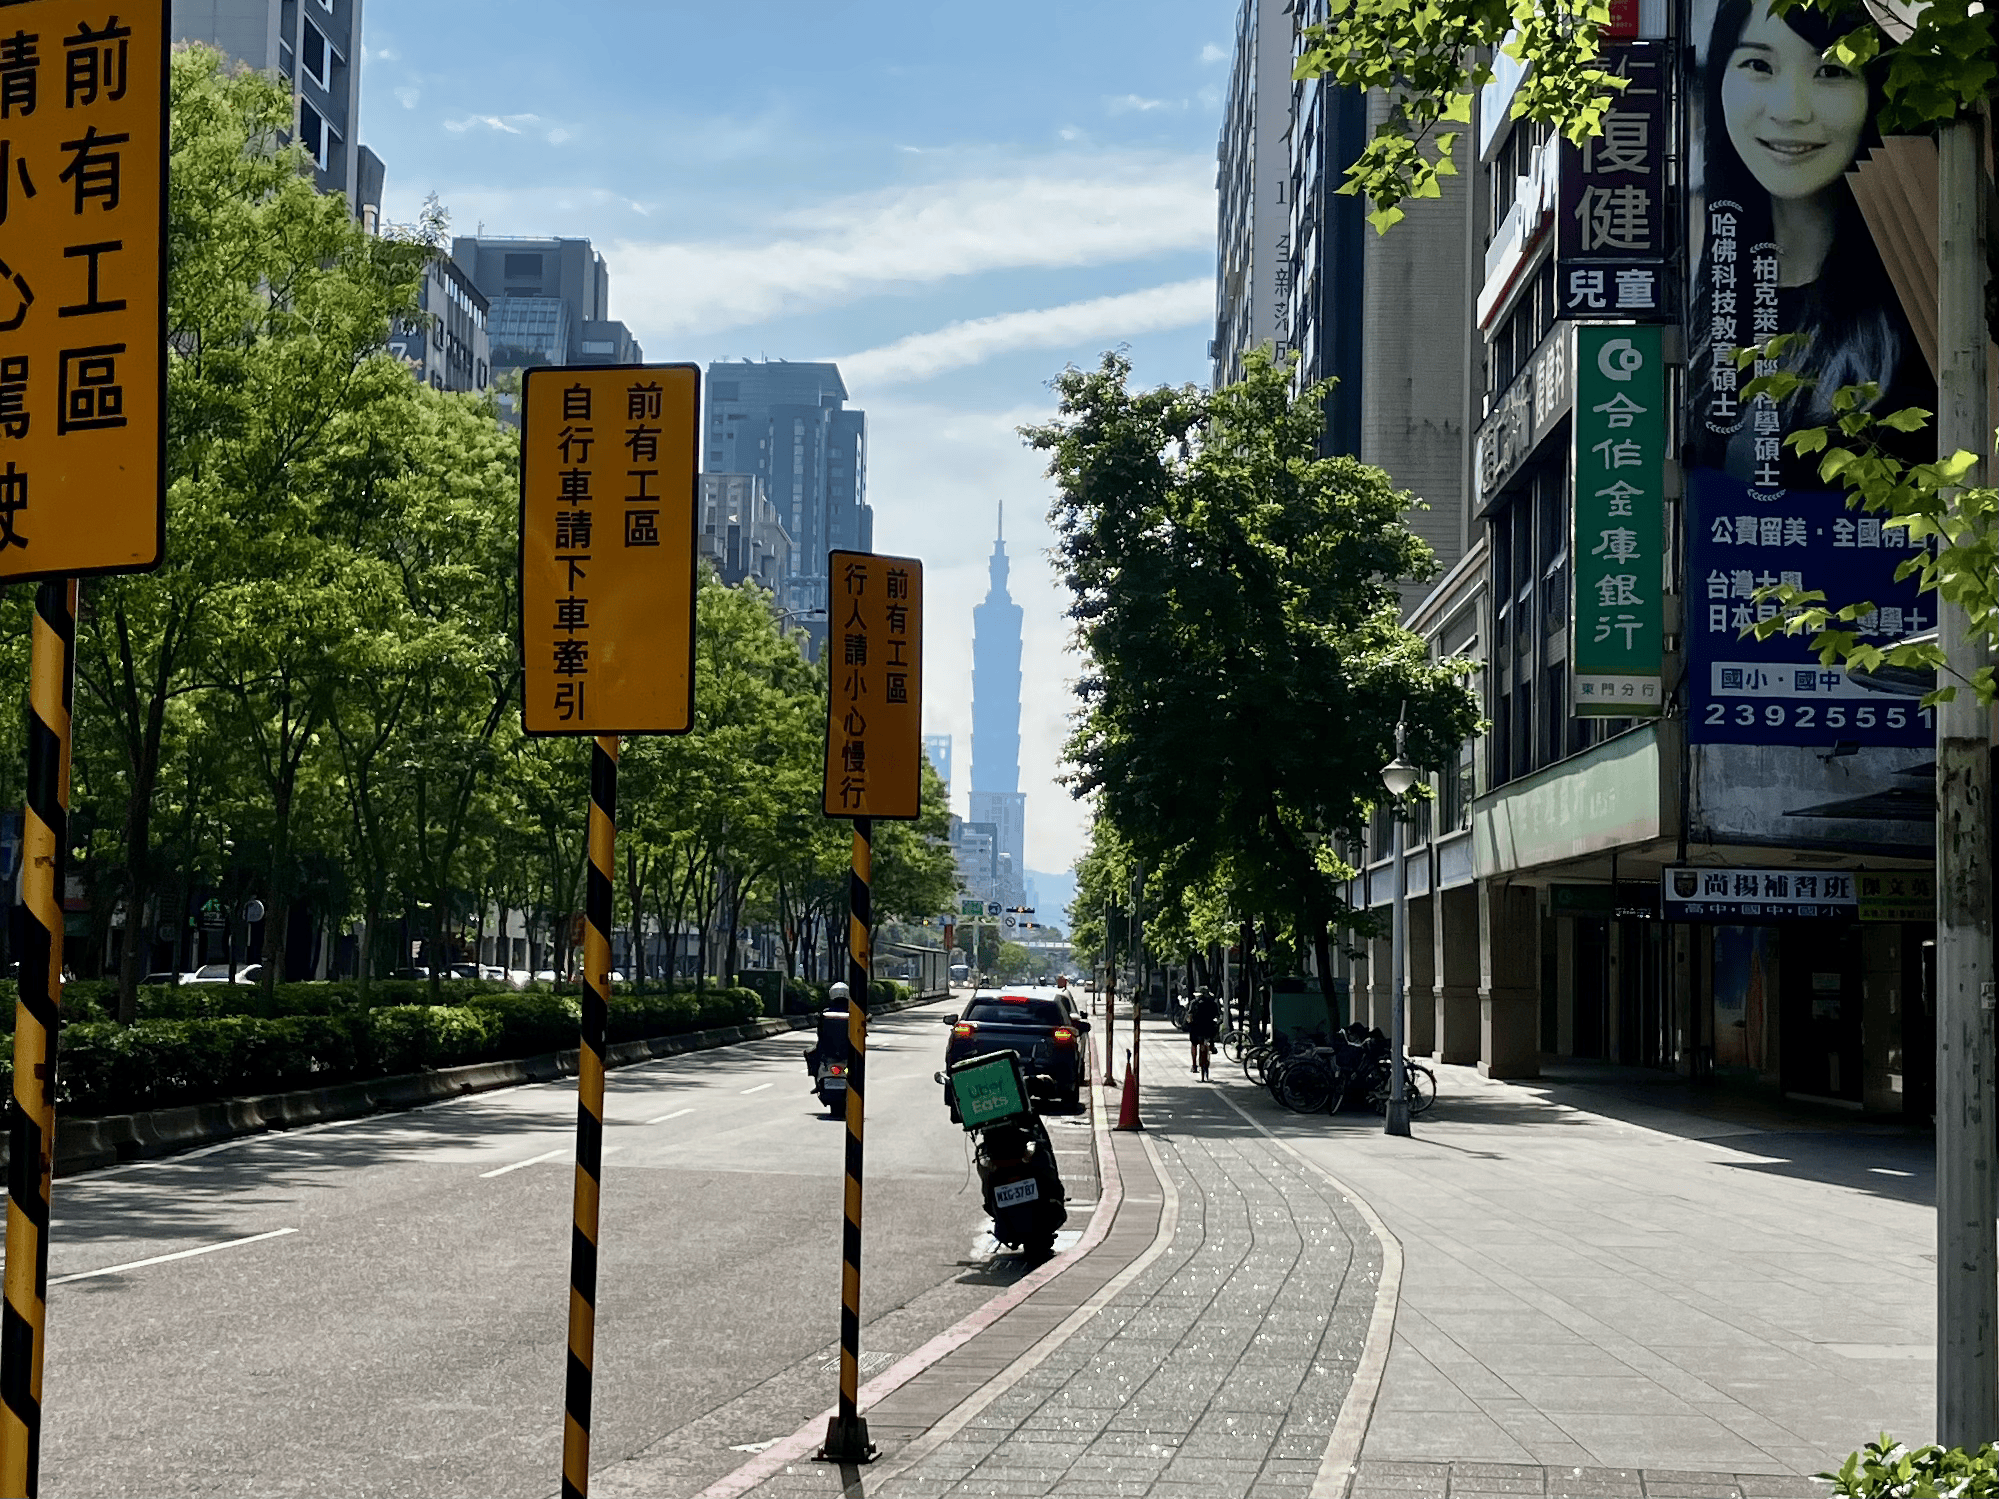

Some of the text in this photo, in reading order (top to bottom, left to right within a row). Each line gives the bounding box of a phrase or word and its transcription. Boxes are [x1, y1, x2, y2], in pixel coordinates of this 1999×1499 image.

[57, 15, 131, 436] 前有工區
[1574, 108, 1651, 251] 復健
[1566, 268, 1656, 309] 兒童
[1711, 213, 1737, 417] 哈佛科技教育碩士
[624, 381, 663, 548] 前有工區
[1591, 392, 1647, 650] 合作金庫銀行
[553, 383, 594, 721] 自行車請下車牽引
[840, 563, 867, 808] 行人請小心慢行
[886, 568, 908, 703] 前有工區
[1581, 682, 1655, 697] 東門分行
[1704, 704, 1932, 728] 23925551
[1704, 873, 1850, 899] 尚揚補習班
[972, 1096, 1009, 1115] Eats
